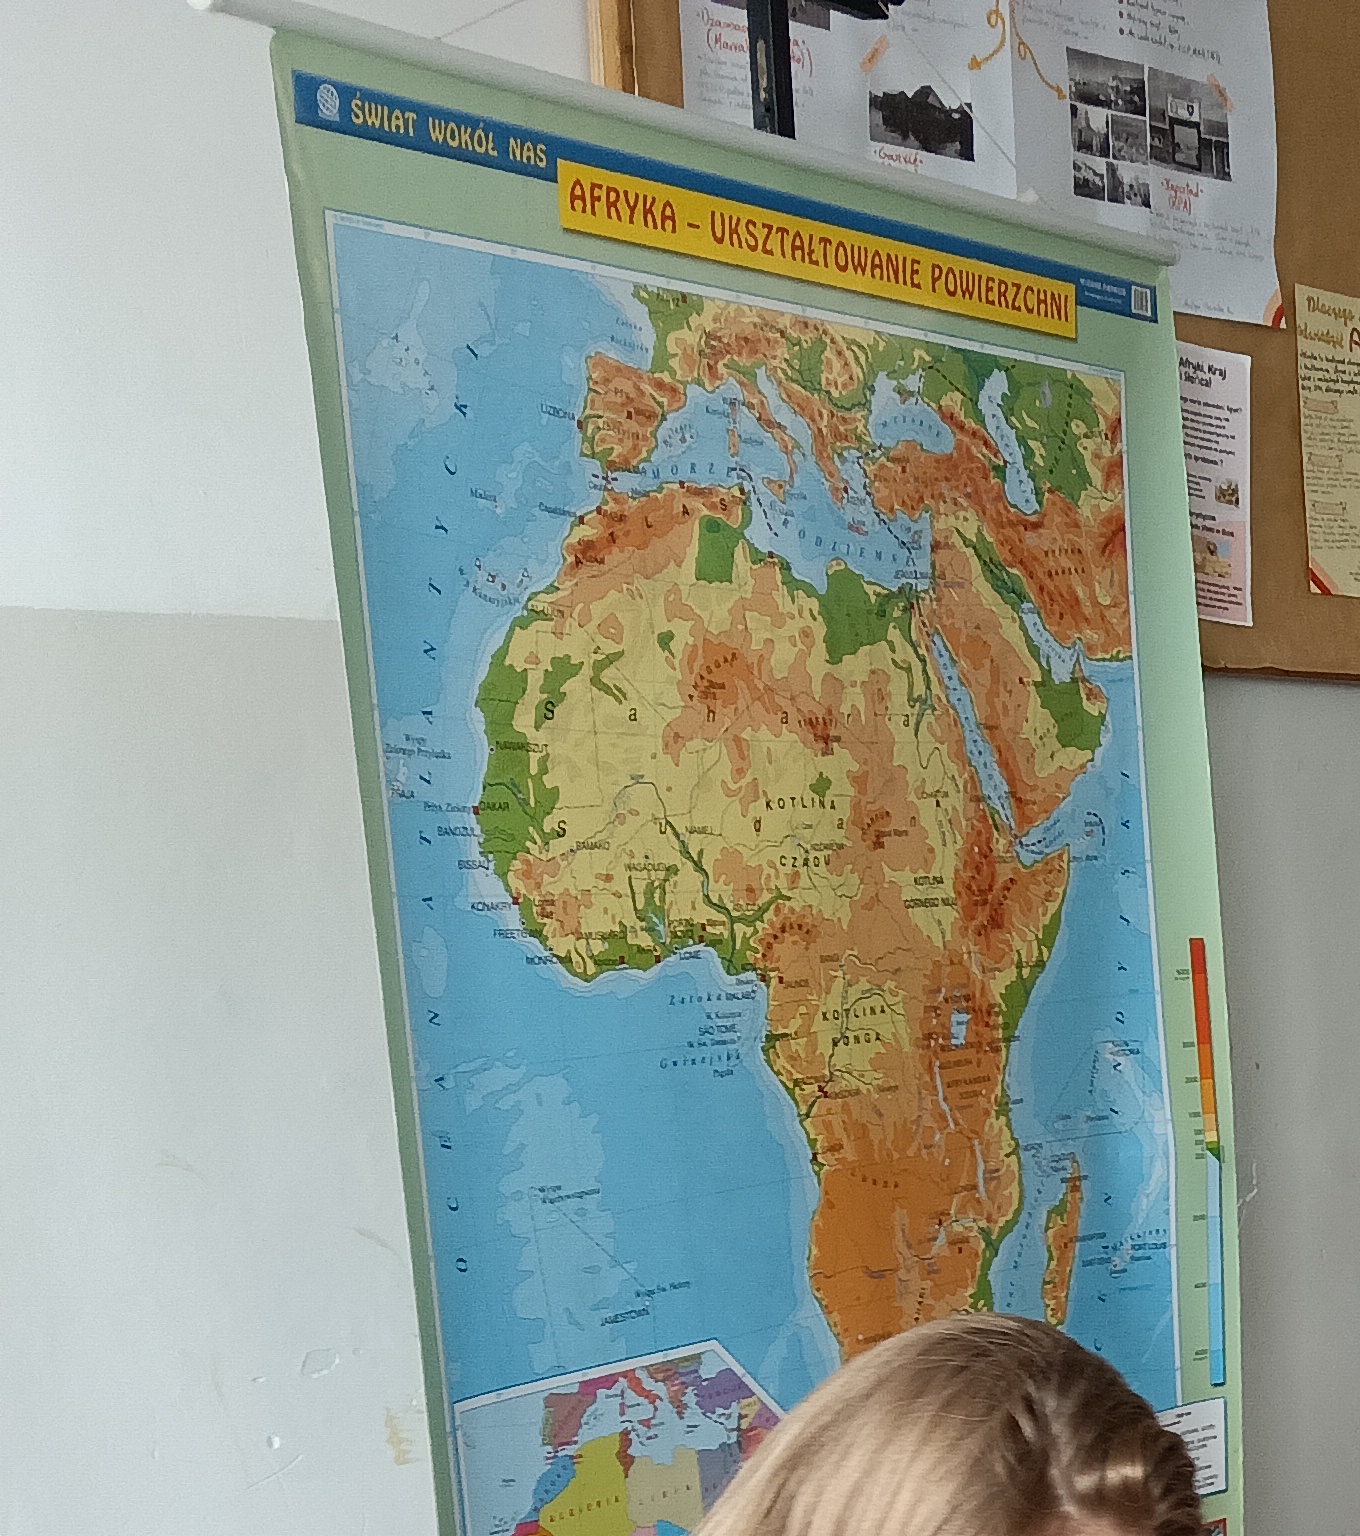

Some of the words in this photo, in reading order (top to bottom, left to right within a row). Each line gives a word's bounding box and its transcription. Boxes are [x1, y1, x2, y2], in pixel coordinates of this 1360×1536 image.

[351, 91, 417, 137] ŚWIAT
[429, 116, 498, 157] WOKÓŁ
[508, 137, 547, 168] NAS
[569, 177, 677, 234] AFRYKA
[710, 210, 922, 290] UKSZTAŁTOWANIE
[930, 262, 1070, 323] POWIERZCHNI
